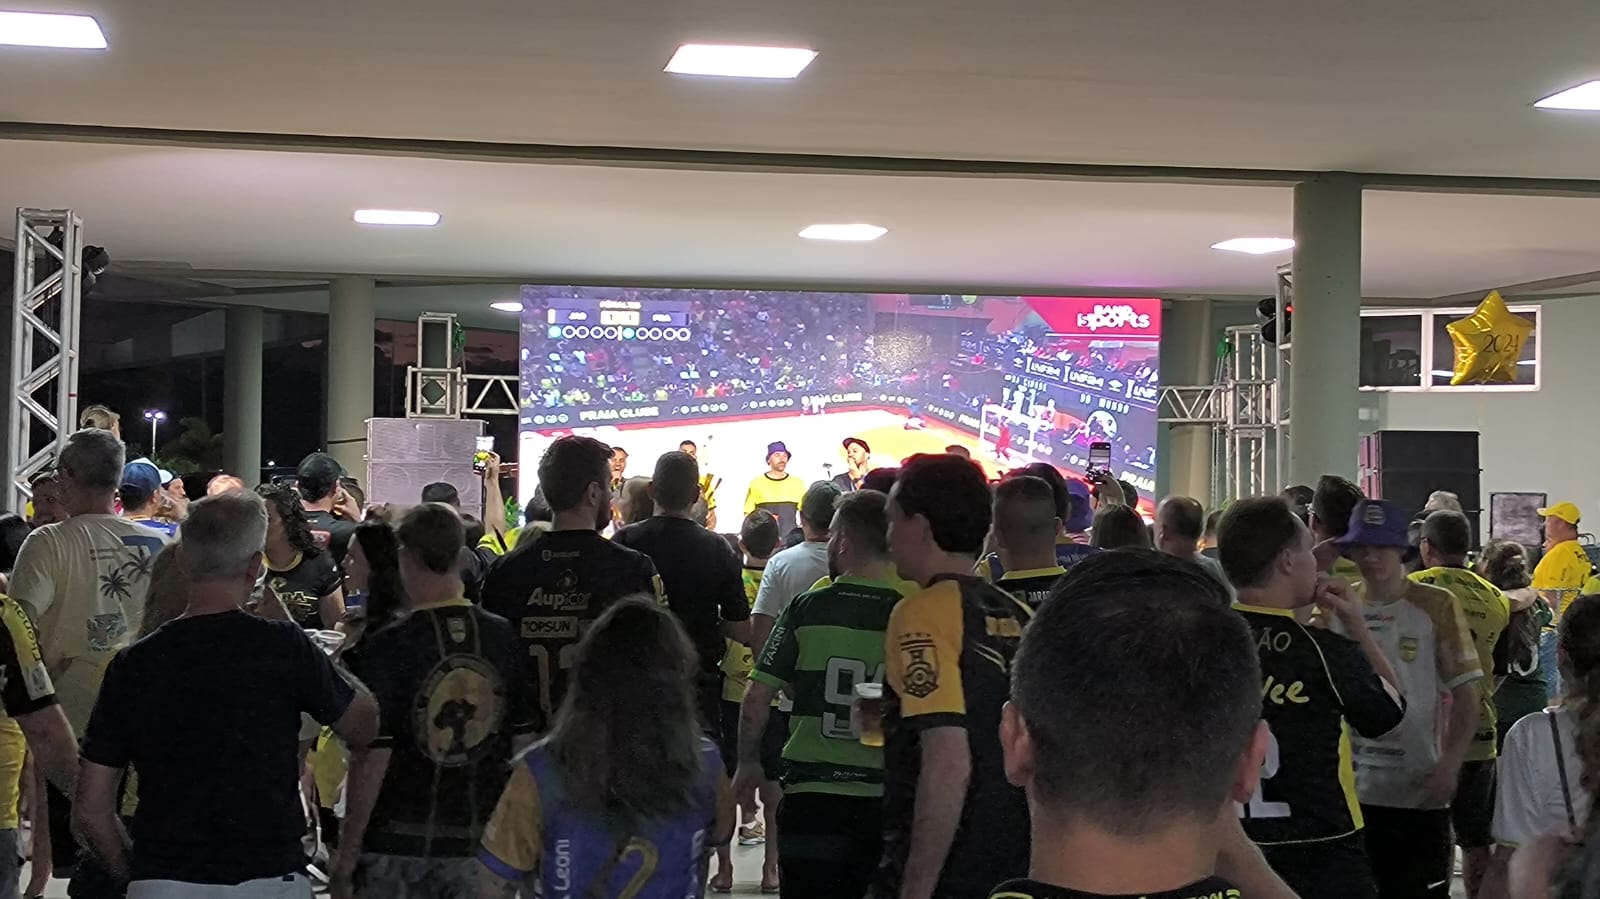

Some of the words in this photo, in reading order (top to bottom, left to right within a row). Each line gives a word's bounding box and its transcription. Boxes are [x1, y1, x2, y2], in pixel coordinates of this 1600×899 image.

[522, 620, 571, 633] TOPSUN
[1256, 626, 1293, 653] ÃO
[762, 626, 787, 668] FAKINI
